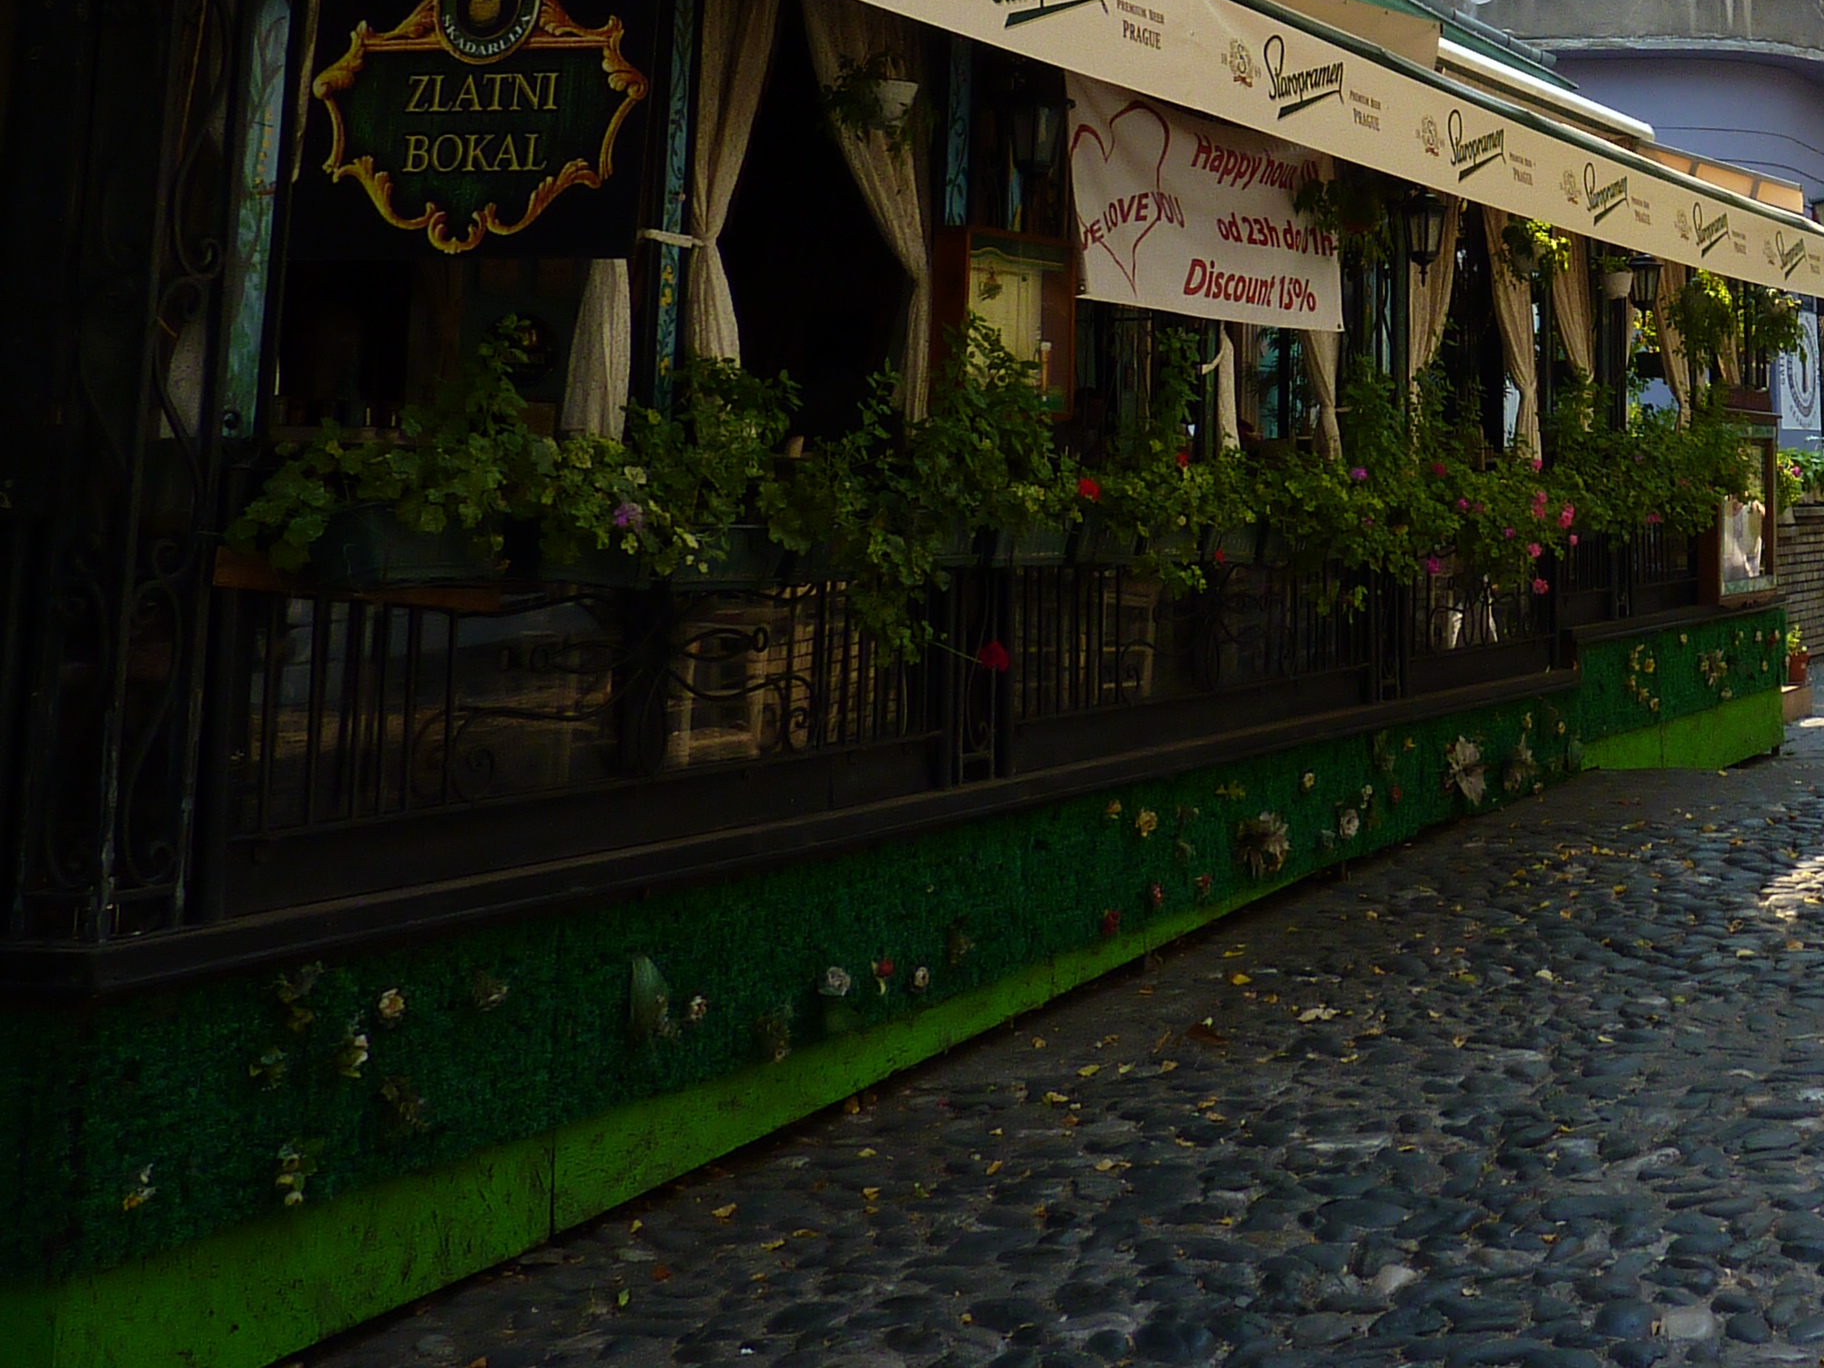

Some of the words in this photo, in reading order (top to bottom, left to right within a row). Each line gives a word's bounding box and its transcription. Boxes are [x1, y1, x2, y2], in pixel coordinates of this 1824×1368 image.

[1122, 19, 1162, 50] PRAGUE
[1263, 34, 1344, 103] Staropramen
[404, 71, 560, 113] ZLATNI
[402, 133, 548, 172] BOKAL
[1190, 132, 1263, 191] Happy
[1259, 148, 1298, 190] hour
[1103, 192, 1150, 233] LOVE
[1150, 191, 1185, 229] YOU
[1216, 212, 1243, 244] od
[1241, 217, 1281, 249] 23h
[1183, 257, 1276, 308] Discount
[1278, 275, 1317, 313] 15%
